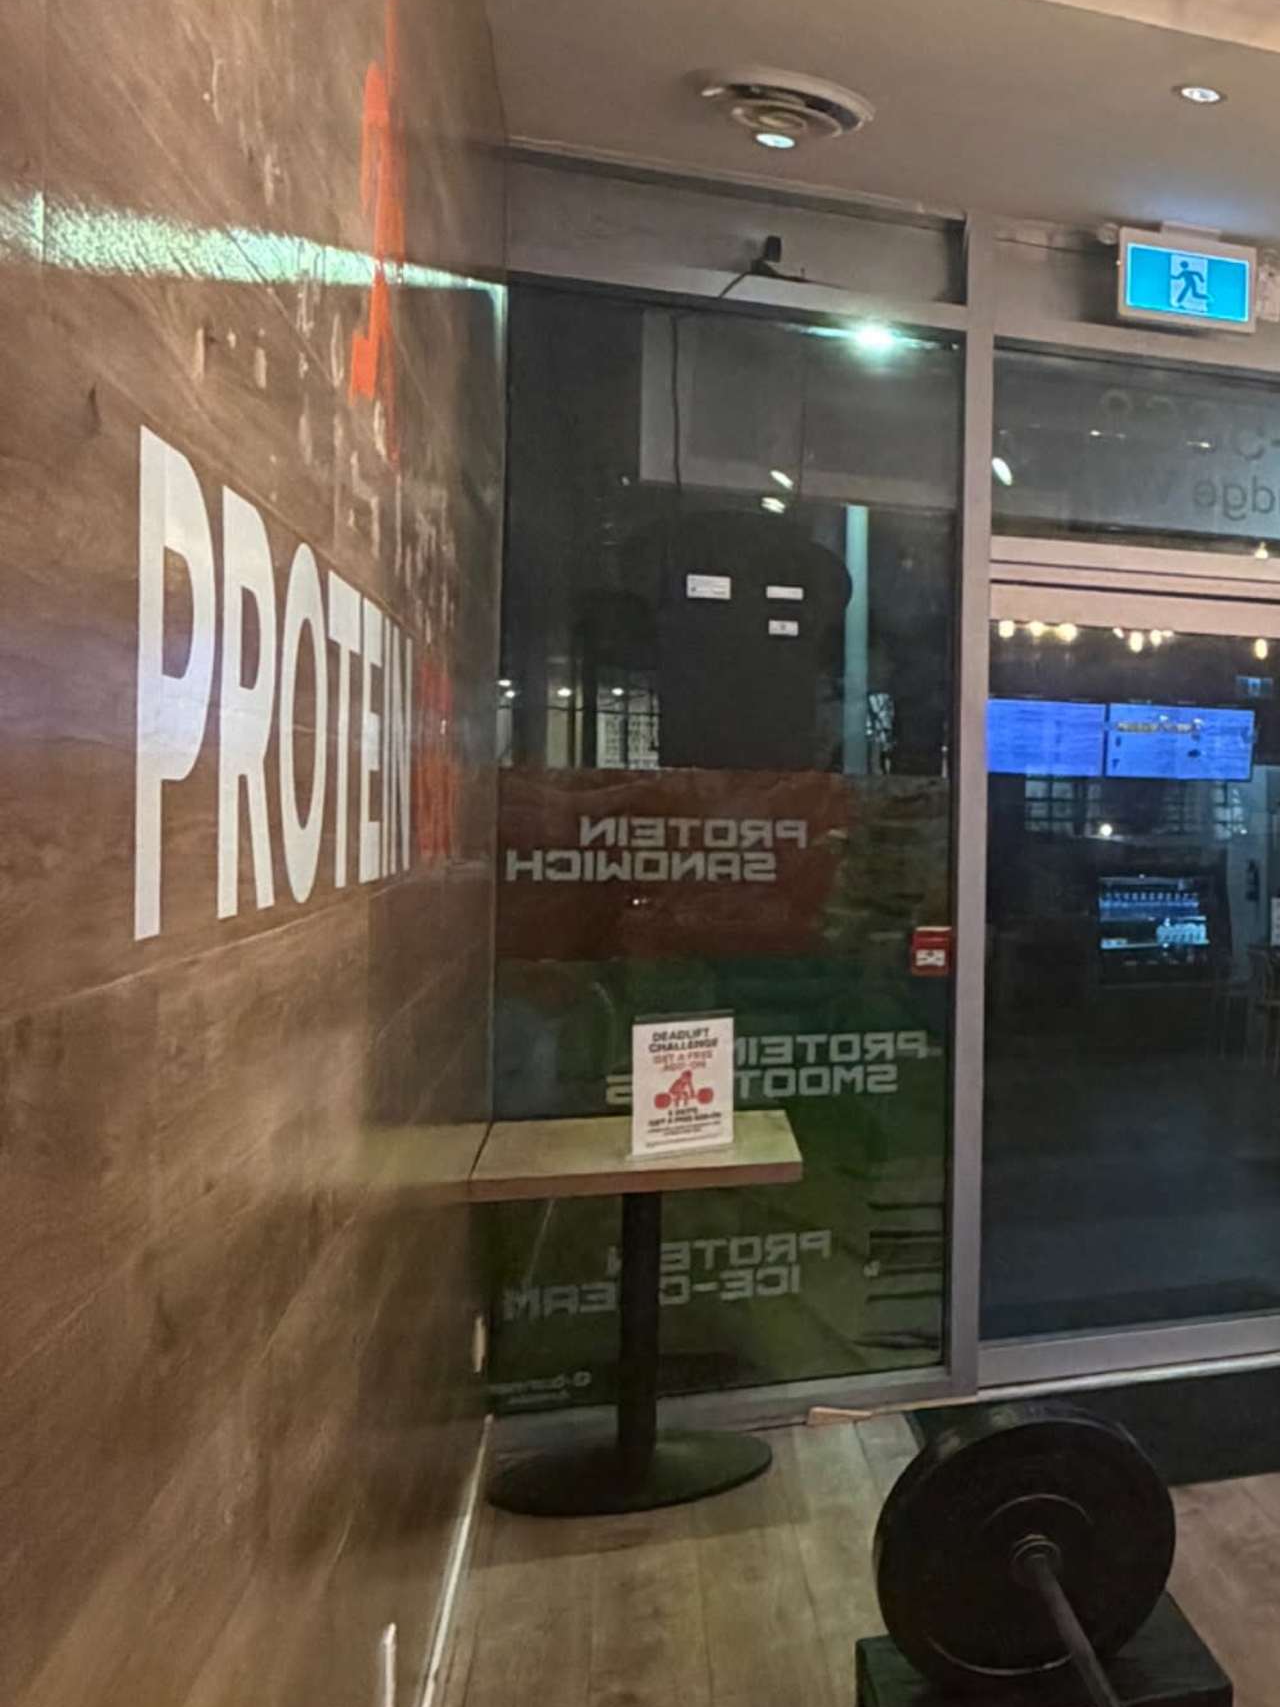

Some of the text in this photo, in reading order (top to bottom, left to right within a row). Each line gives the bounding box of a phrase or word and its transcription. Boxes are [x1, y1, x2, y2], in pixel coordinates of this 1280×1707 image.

[134, 425, 413, 941] PROTEIN
[653, 1028, 709, 1041] DEADLIFT
[649, 1039, 717, 1052] CHALLENGE
